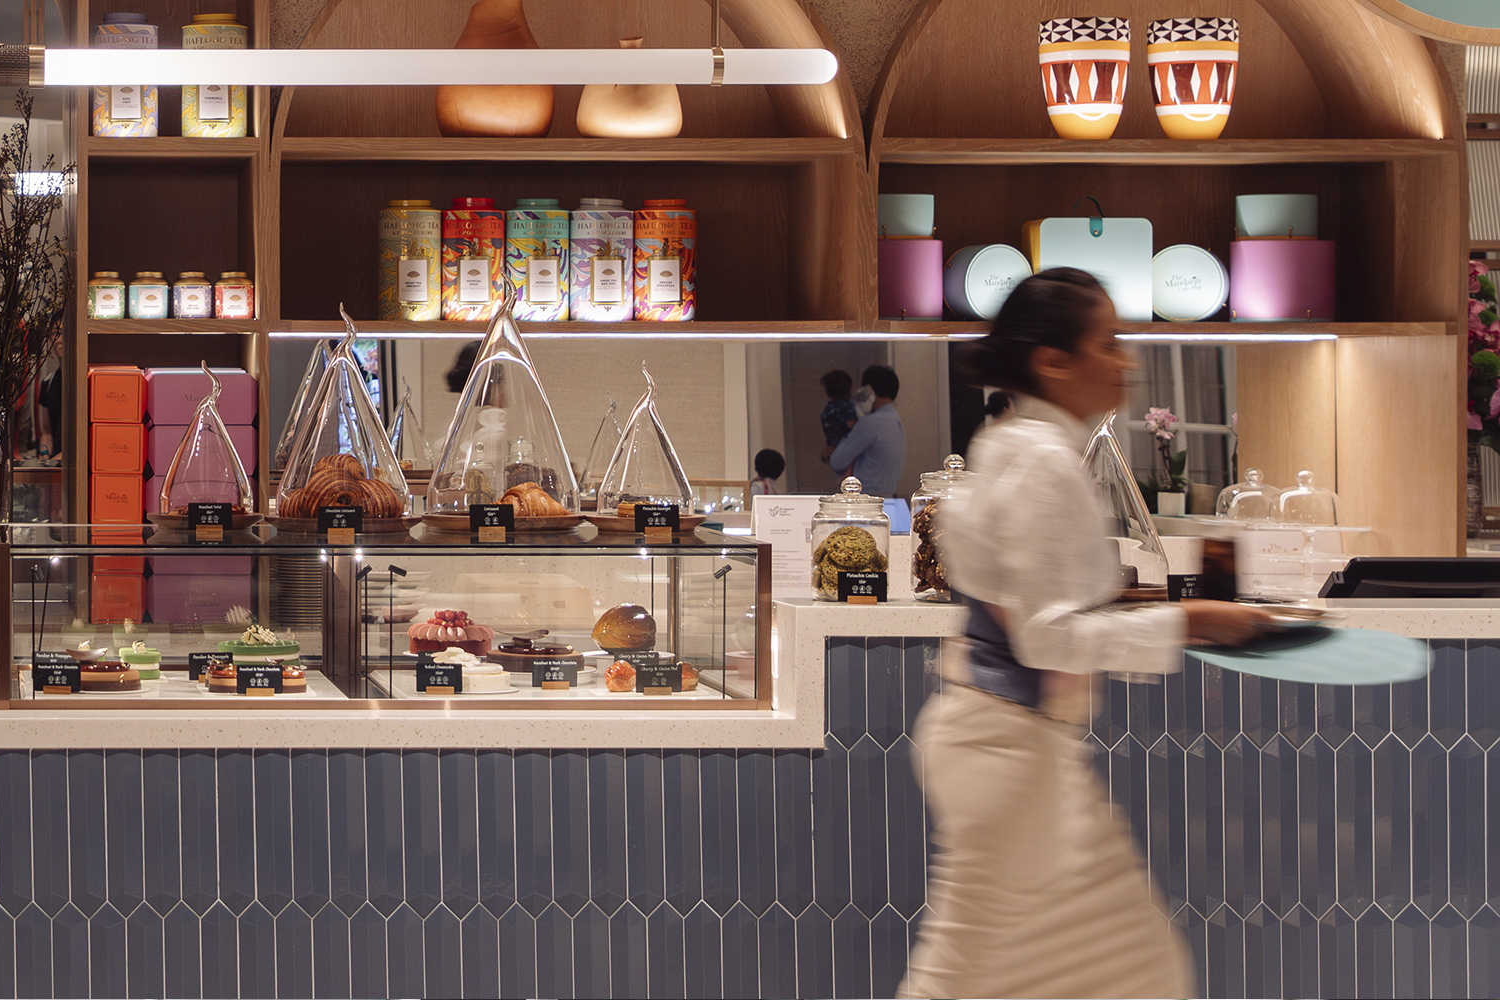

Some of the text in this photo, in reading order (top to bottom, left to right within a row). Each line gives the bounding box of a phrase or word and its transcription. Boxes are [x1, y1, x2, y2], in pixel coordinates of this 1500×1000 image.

[185, 36, 243, 45] HAFLONG TEA
[513, 221, 556, 230] HAFLONG
[577, 221, 621, 230] HAFLONG
[679, 222, 693, 230] TEA
[1165, 278, 1202, 287] Mandarin
